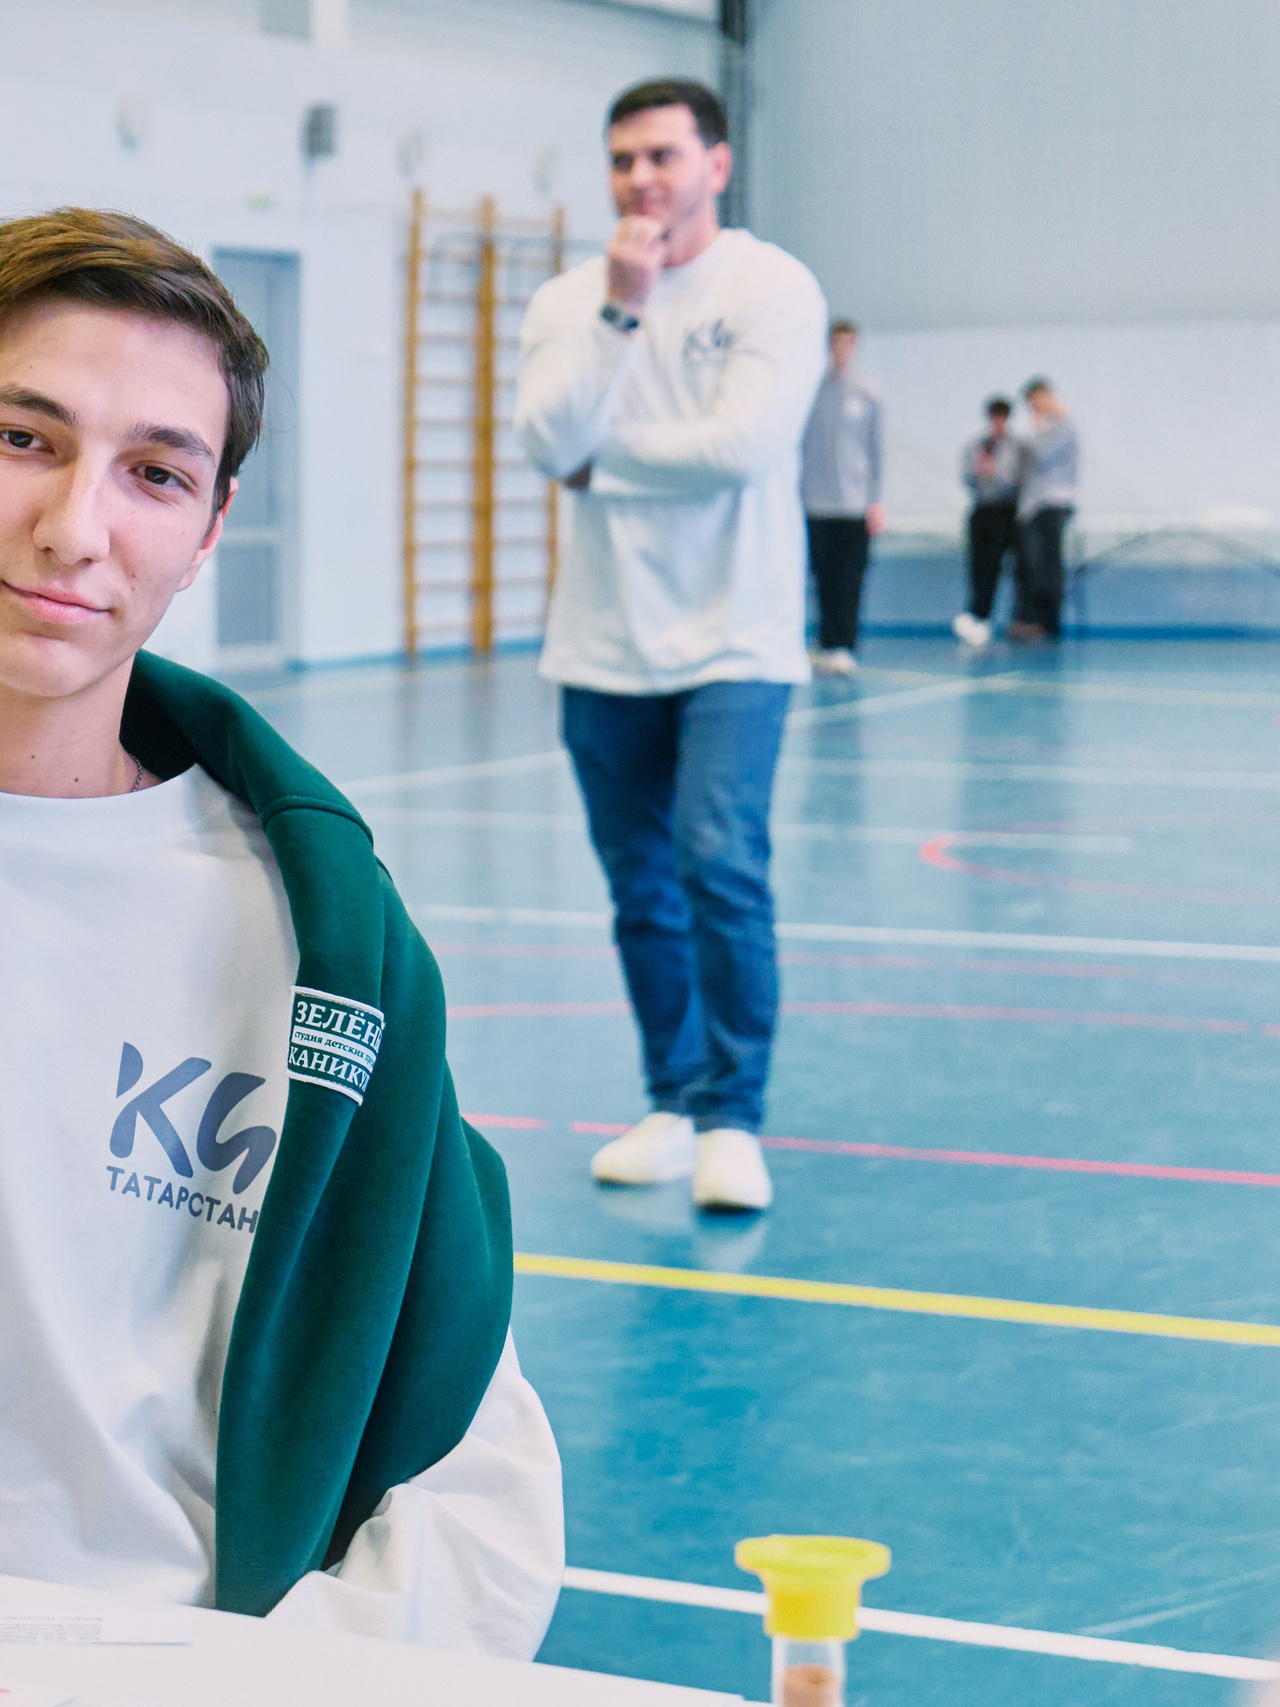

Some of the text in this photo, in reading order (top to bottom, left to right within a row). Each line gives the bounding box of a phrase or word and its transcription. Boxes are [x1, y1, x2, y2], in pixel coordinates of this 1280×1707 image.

[294, 1000, 382, 1054] ЗЕЛЁН
[324, 1038, 365, 1060] детских
[288, 1045, 371, 1093] КАНИКУ
[106, 1165, 259, 1234] ТАТАРСТАН
